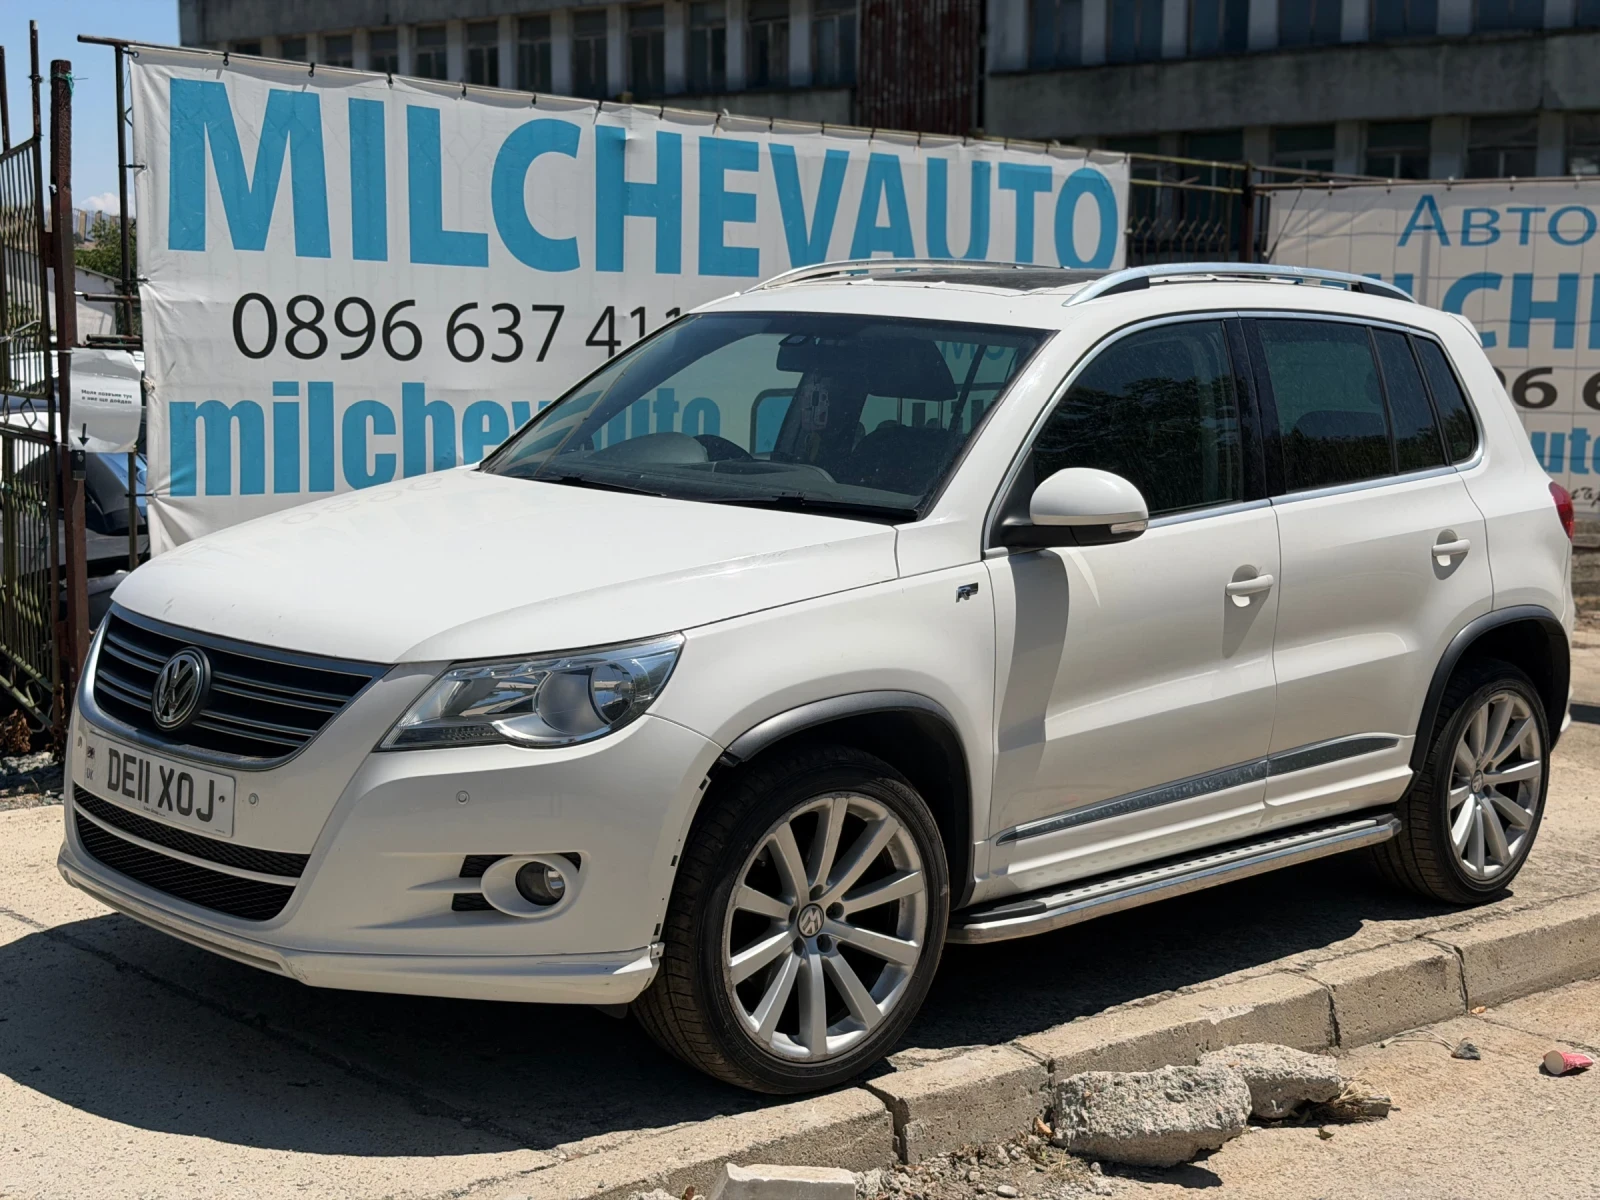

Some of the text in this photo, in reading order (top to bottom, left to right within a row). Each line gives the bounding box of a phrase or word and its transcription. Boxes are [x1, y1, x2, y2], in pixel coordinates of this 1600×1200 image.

[168, 77, 1118, 277] MILCHEVAUTO
[232, 292, 681, 362] 0896 637 41
[157, 765, 215, 823] XOJ
